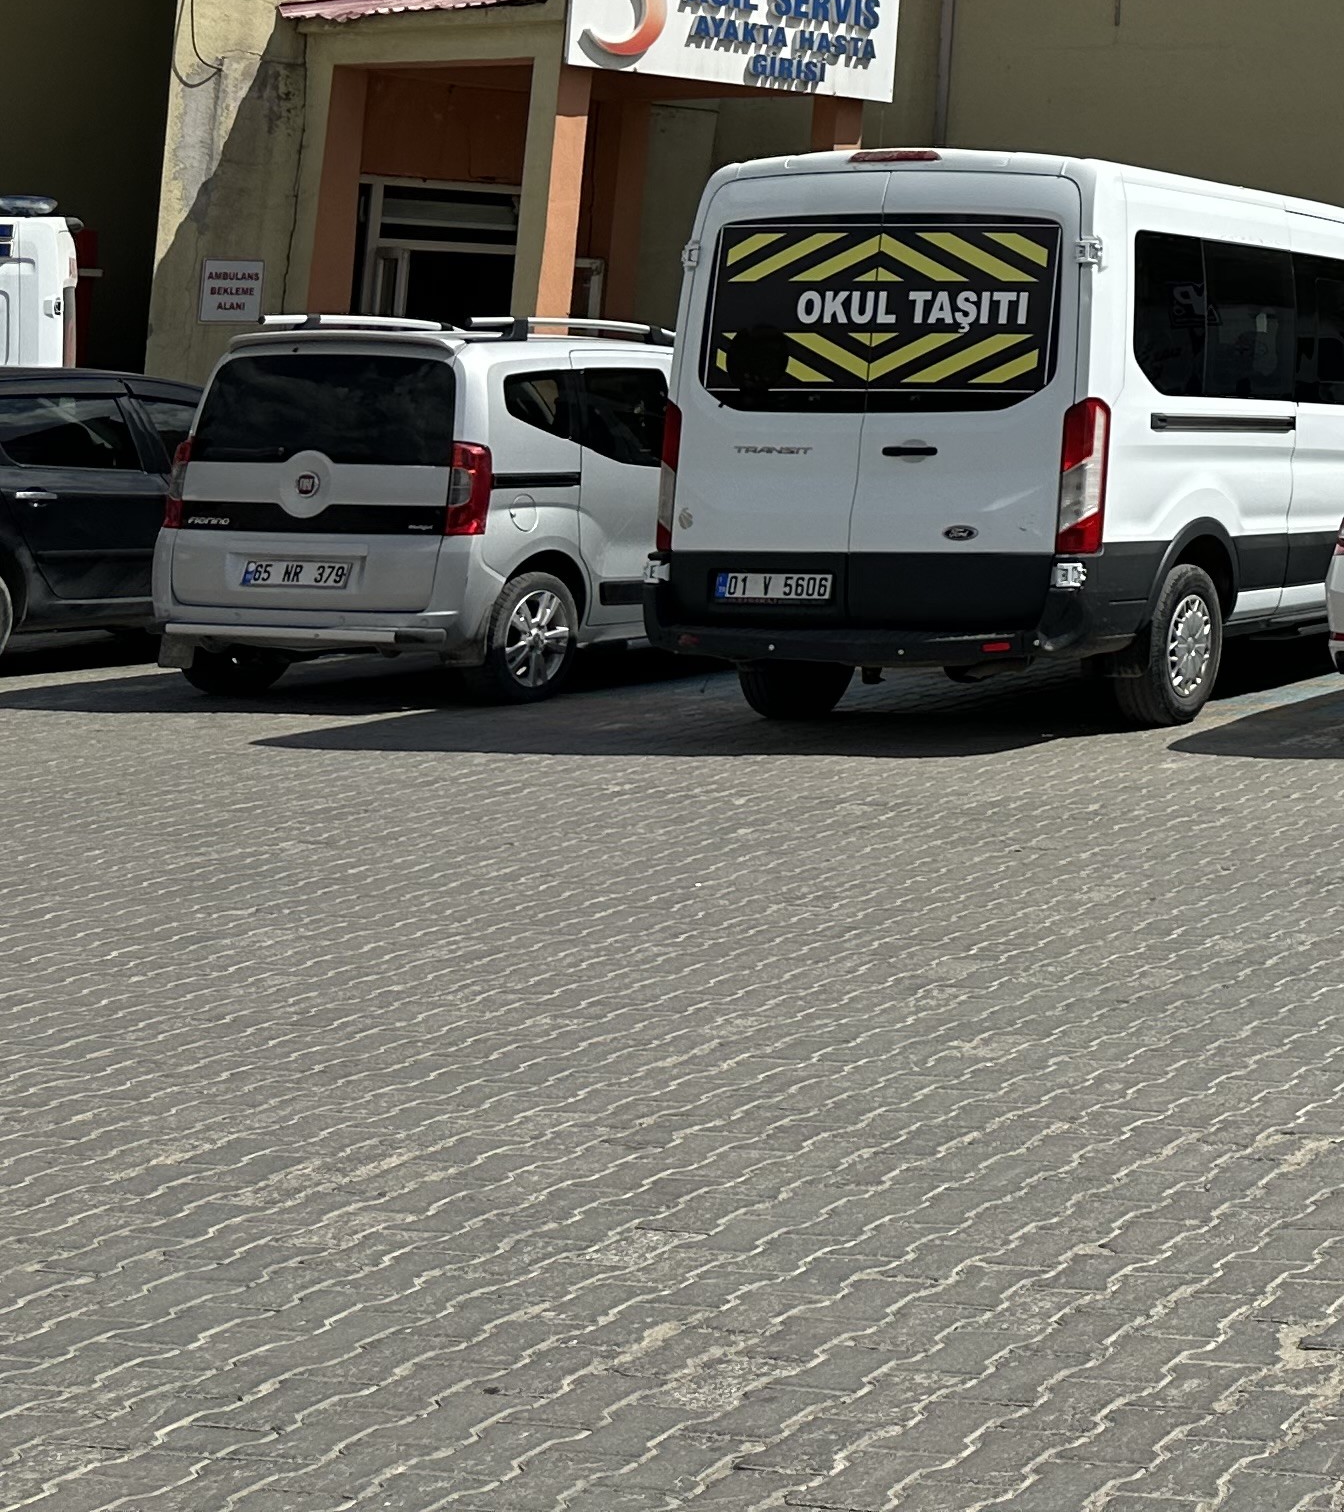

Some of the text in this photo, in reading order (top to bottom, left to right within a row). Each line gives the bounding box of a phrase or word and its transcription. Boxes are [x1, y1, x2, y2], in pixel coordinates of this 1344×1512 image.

[694, 15, 876, 58] AYAKTA HASTA
[208, 271, 259, 281] AMBULANS
[210, 286, 255, 296] BEKLEME
[216, 302, 245, 310] ALANI
[797, 291, 1029, 333] OKUL TAŞITI
[727, 575, 748, 596] 01
[783, 576, 828, 597] 5606
